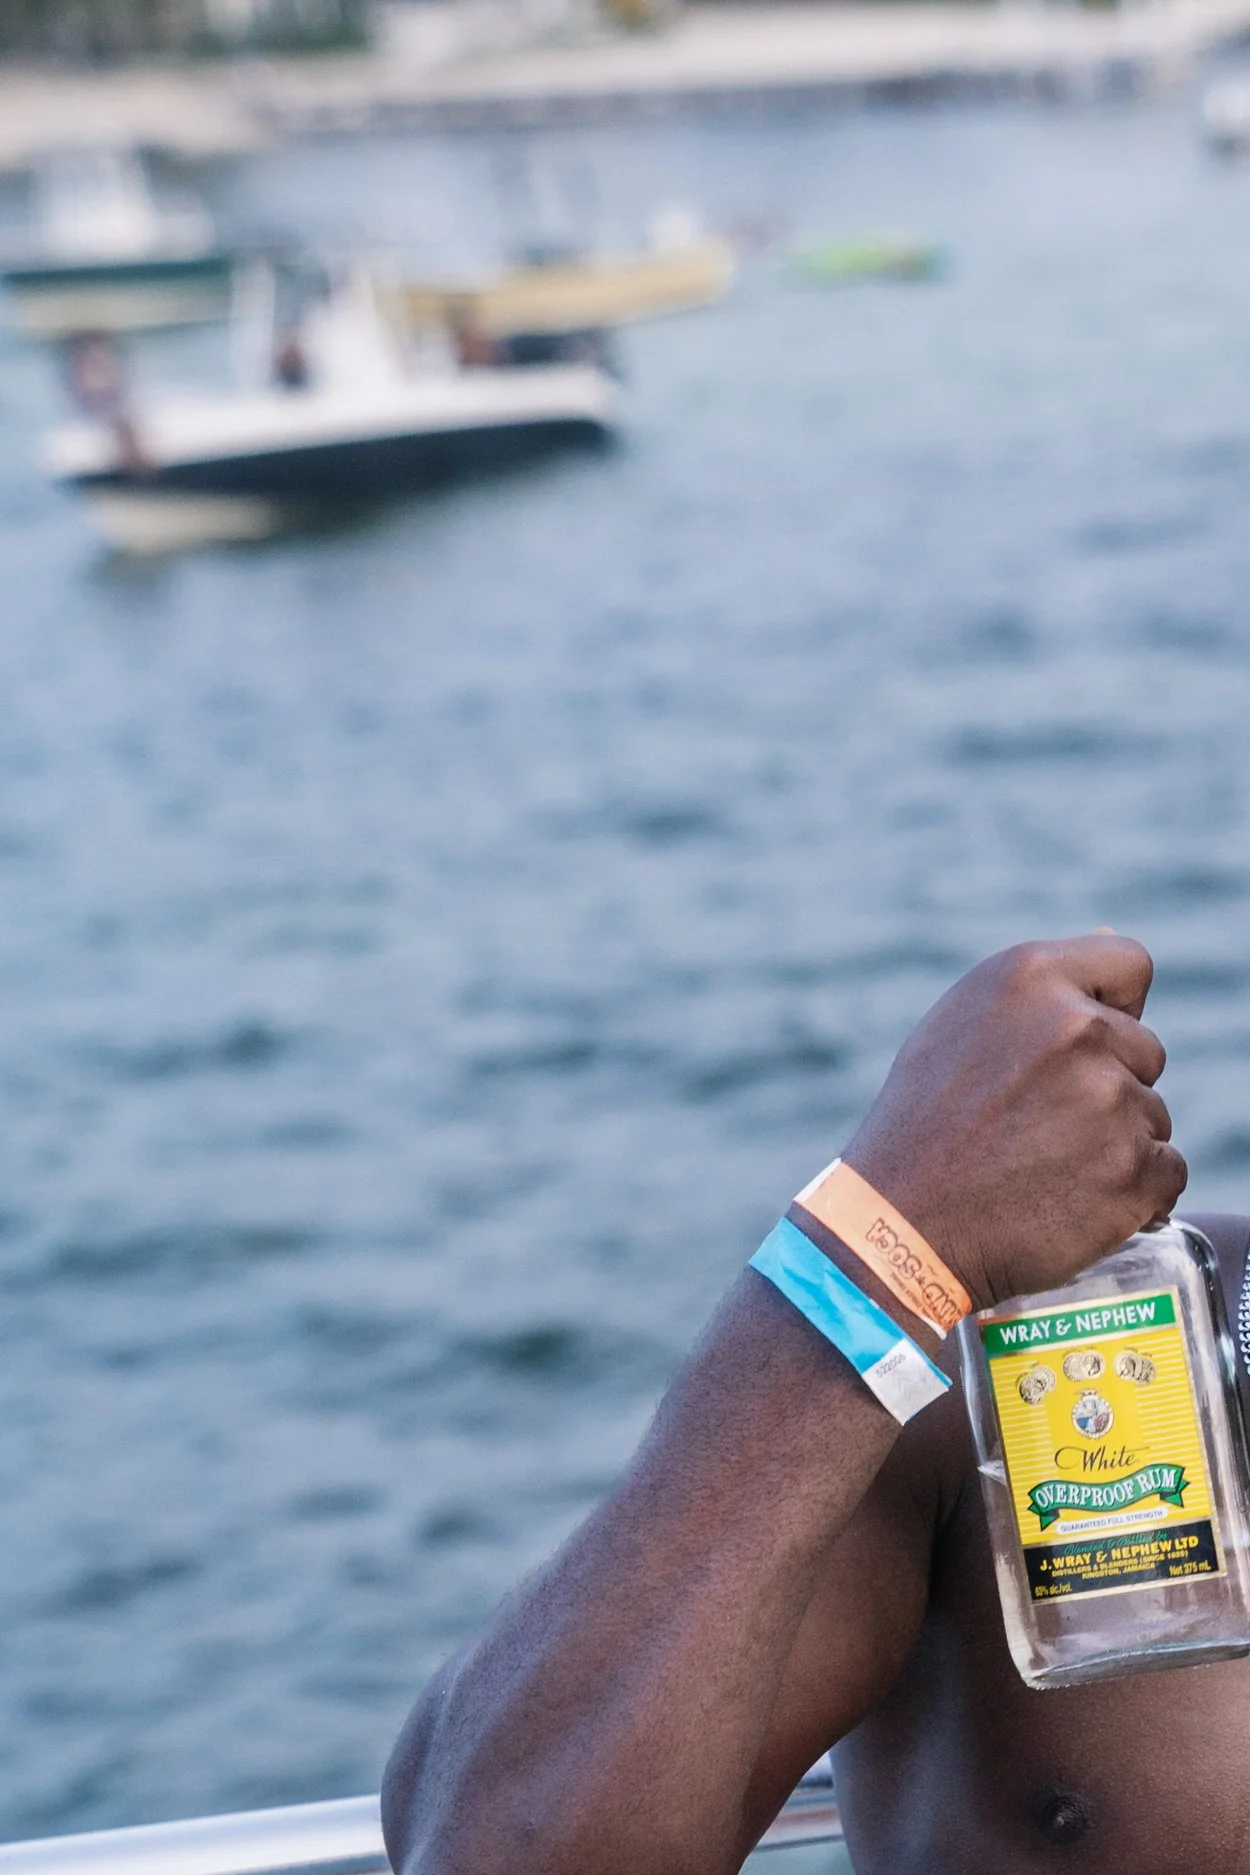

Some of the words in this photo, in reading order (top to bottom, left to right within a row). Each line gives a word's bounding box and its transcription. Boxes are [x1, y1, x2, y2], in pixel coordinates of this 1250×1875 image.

[865, 1217, 923, 1280] SOCA
[1000, 1320, 1051, 1345] WRAY
[1055, 1318, 1072, 1336] &
[1075, 1302, 1156, 1333] NEPHEW
[1054, 1446, 1150, 1473] White
[1035, 1481, 1134, 1508] OVERPROOF
[1138, 1467, 1177, 1495] RUM
[1060, 1518, 1107, 1533] GUARANTEED
[1107, 1515, 1126, 1527] FULL
[1126, 1510, 1164, 1523] STRENGTH
[1040, 1560, 1052, 1571] J.
[1052, 1553, 1091, 1569] WRAY
[1096, 1551, 1108, 1563] &
[1111, 1539, 1172, 1560] NEPHEW
[1174, 1535, 1199, 1550] LTD
[1052, 1564, 1092, 1577] DISTILLERS
[1122, 1562, 1156, 1574] JAMAICA
[1169, 1565, 1183, 1577] Net
[1184, 1561, 1198, 1574] 375
